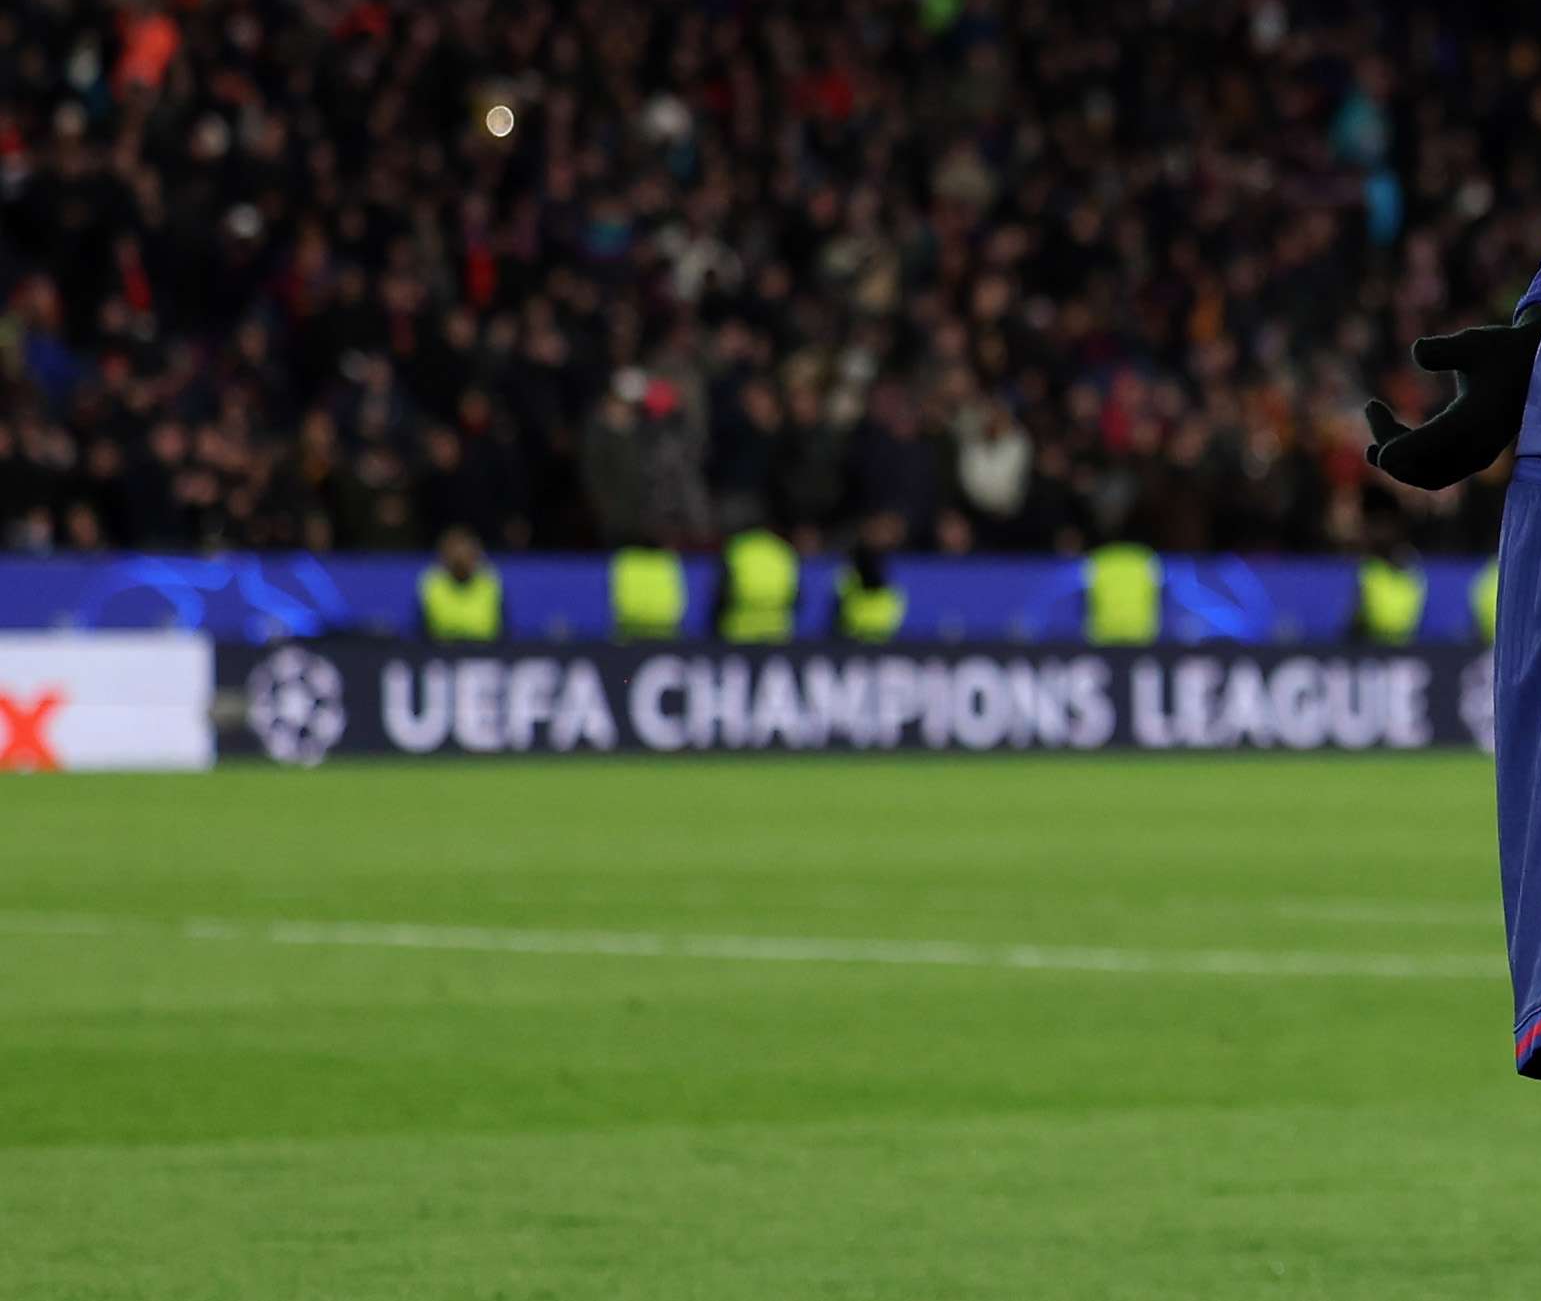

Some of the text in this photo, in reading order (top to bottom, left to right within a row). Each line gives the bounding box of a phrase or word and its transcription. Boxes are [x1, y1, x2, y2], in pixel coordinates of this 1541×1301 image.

[380, 653, 1434, 753] UEFA CHAMPIONS LEAGUE
